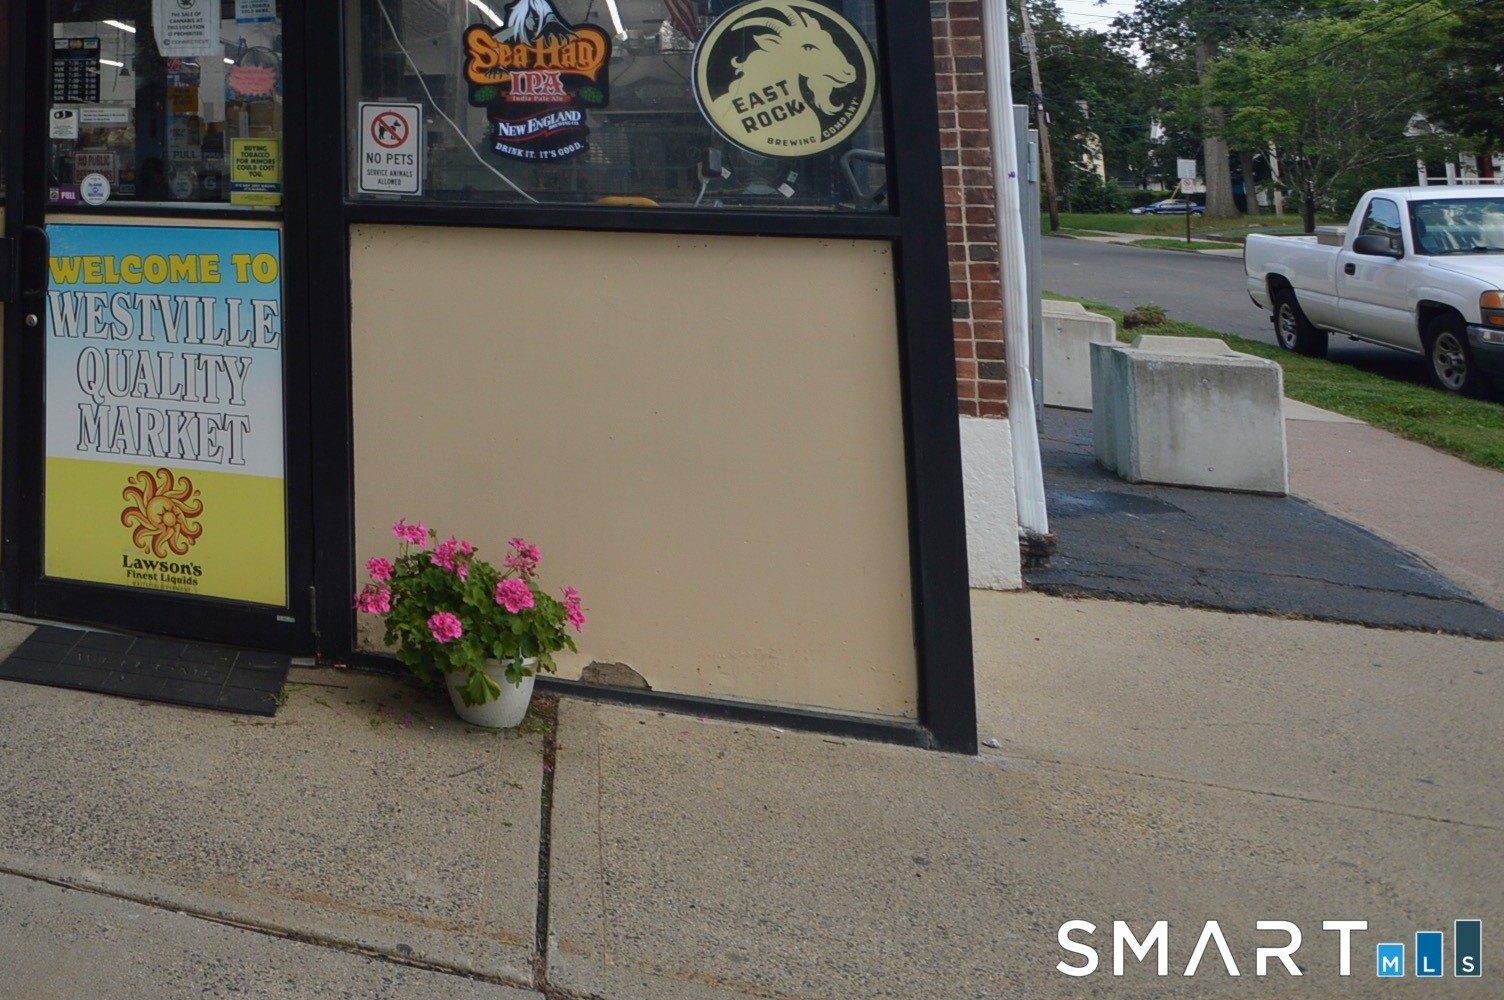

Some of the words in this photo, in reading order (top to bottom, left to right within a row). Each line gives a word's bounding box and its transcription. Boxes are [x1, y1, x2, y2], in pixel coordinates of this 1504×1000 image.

[468, 29, 529, 73] Sea
[510, 70, 566, 95] IPA
[732, 80, 790, 114] EAST
[499, 122, 527, 136] NEW
[527, 110, 581, 134] ENGLAND
[741, 99, 806, 133] ROCK
[767, 136, 816, 147] BREWING
[823, 97, 859, 138] COMPANY
[366, 152, 382, 165] NO
[386, 153, 414, 165] PETS
[496, 142, 523, 157] DRINK
[525, 150, 536, 159] IT.
[540, 148, 556, 159] IT'S
[558, 142, 584, 157] GOOD.
[378, 178, 402, 186] ALLOWED
[390, 170, 413, 178] ANIMALS
[61, 191, 76, 200] PULL
[48, 253, 222, 284] WELCOME
[231, 252, 280, 284] TO
[47, 289, 281, 350] WESTVILLE
[77, 346, 253, 407] QUALITY
[76, 402, 252, 466] MARKET
[122, 554, 203, 577] Lawson's
[127, 569, 157, 581] Finest
[160, 573, 199, 586] Liquids
